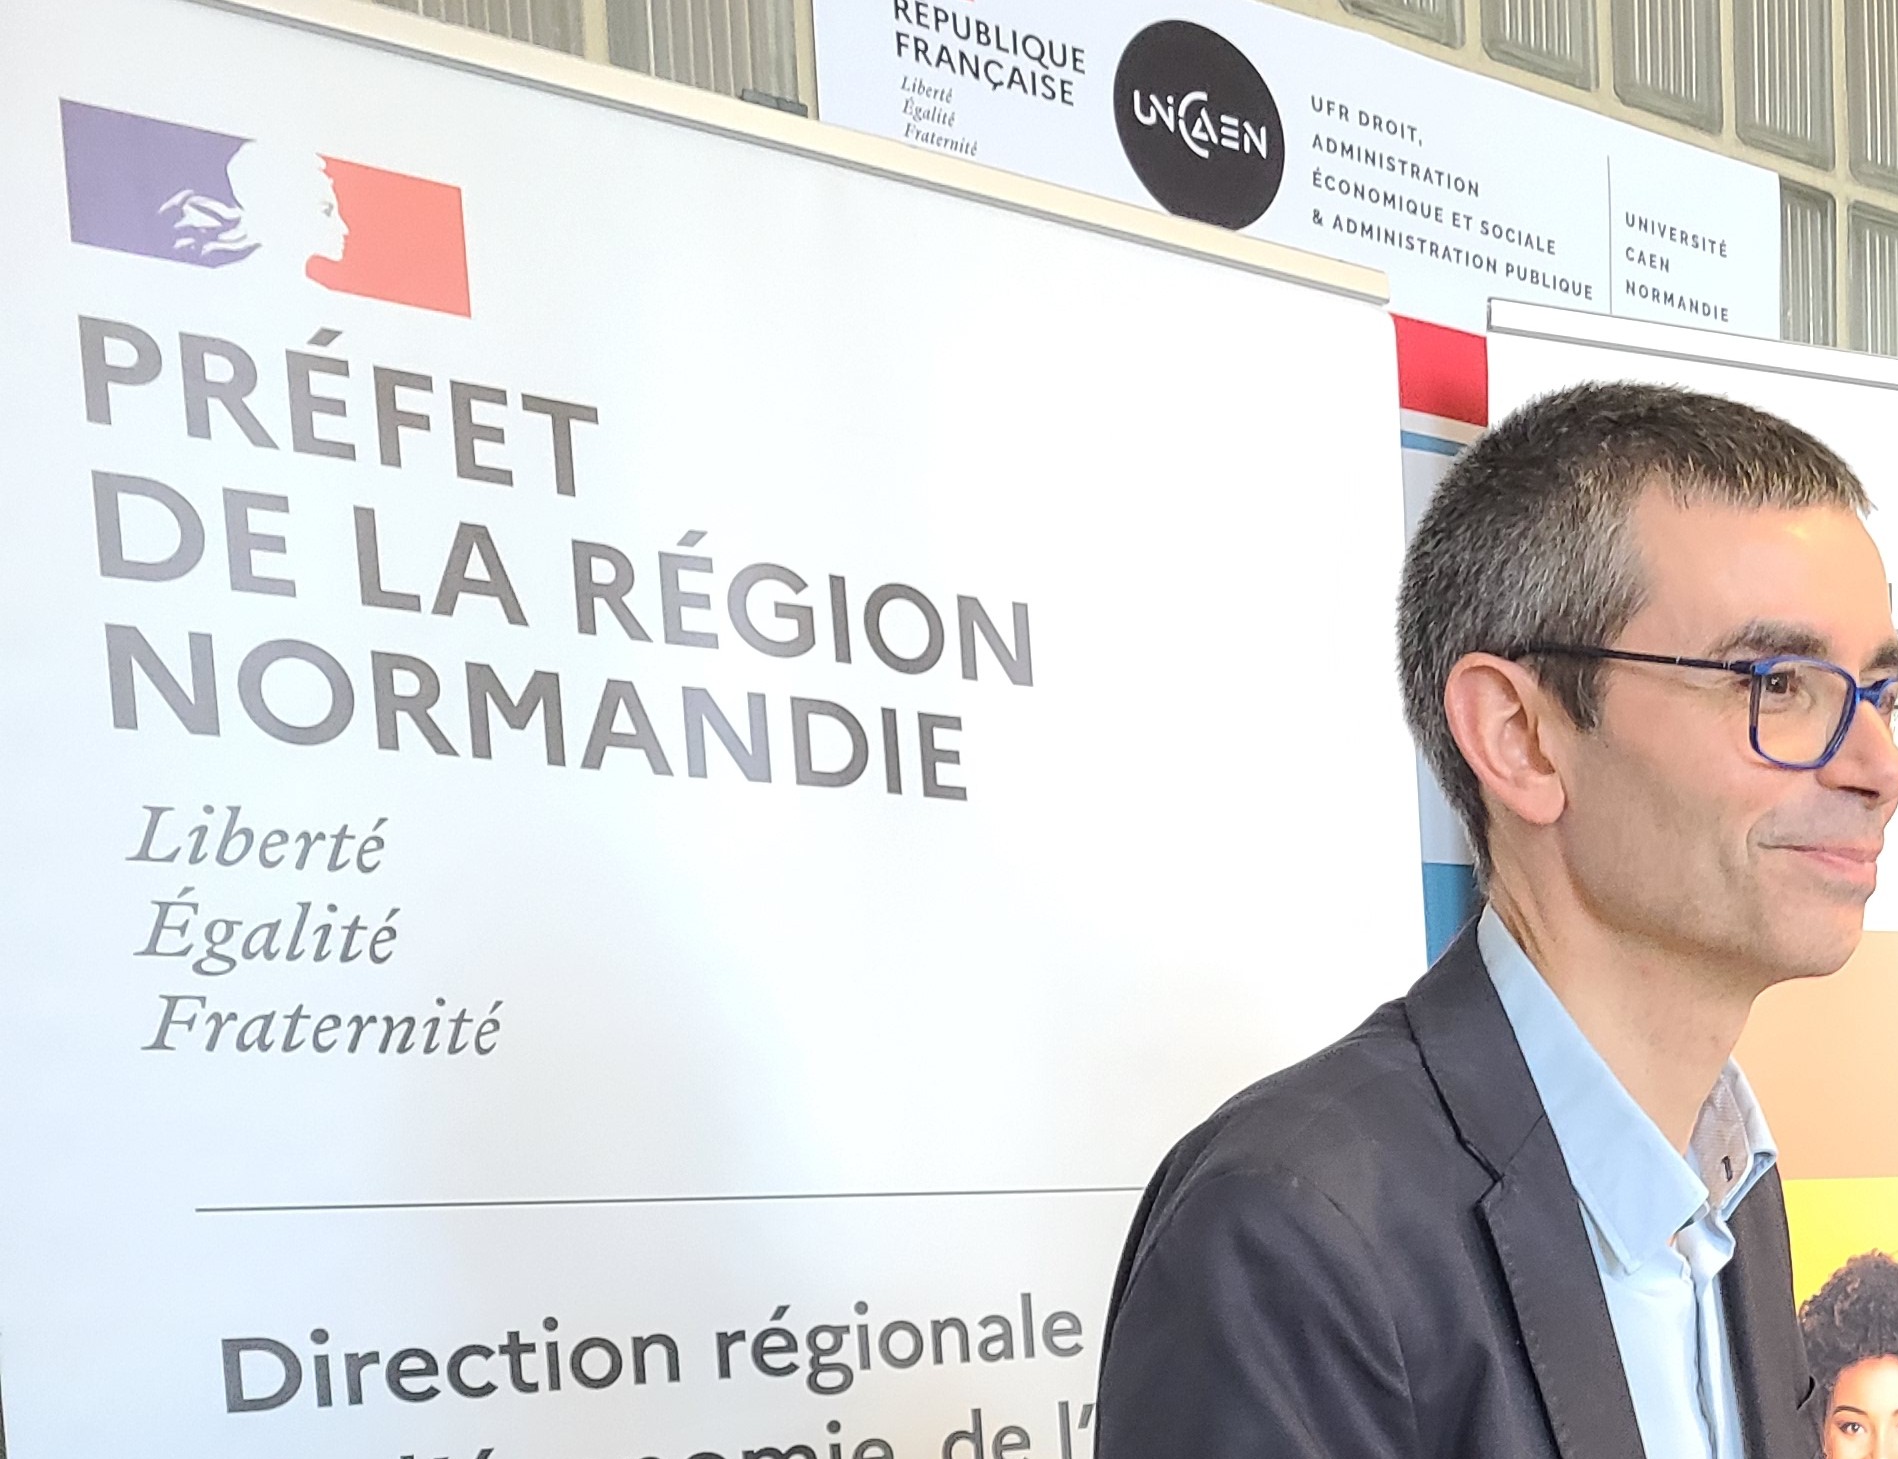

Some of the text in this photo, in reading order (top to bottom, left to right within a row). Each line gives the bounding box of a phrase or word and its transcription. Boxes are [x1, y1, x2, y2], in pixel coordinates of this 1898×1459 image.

[895, 31, 1074, 107] FRANÇAISE
[901, 75, 953, 104] Liberté
[902, 97, 955, 127] Égalité
[904, 122, 978, 157] Fraternité
[1311, 94, 1423, 148] UFR DROIT,
[1312, 133, 1480, 198] ADMINISTRATION
[1312, 166, 1556, 256] ÉCONOMIQUE ET SOCIALE
[1625, 211, 1728, 259] UNIVERSITÉ
[1312, 208, 1593, 301] & ADMINISTRATION PUBLIQUE
[1625, 246, 1670, 274] CAEN
[1625, 278, 1729, 323] NORMANDIE
[77, 313, 599, 498] PRÉFET
[91, 468, 1035, 688] DE LA RÉGION
[104, 621, 969, 802] NORMANDIE
[125, 804, 389, 874] Liberté
[133, 886, 401, 977] Égalité
[140, 994, 504, 1057] Fraternité
[220, 1292, 1085, 1415] Direction régionale
